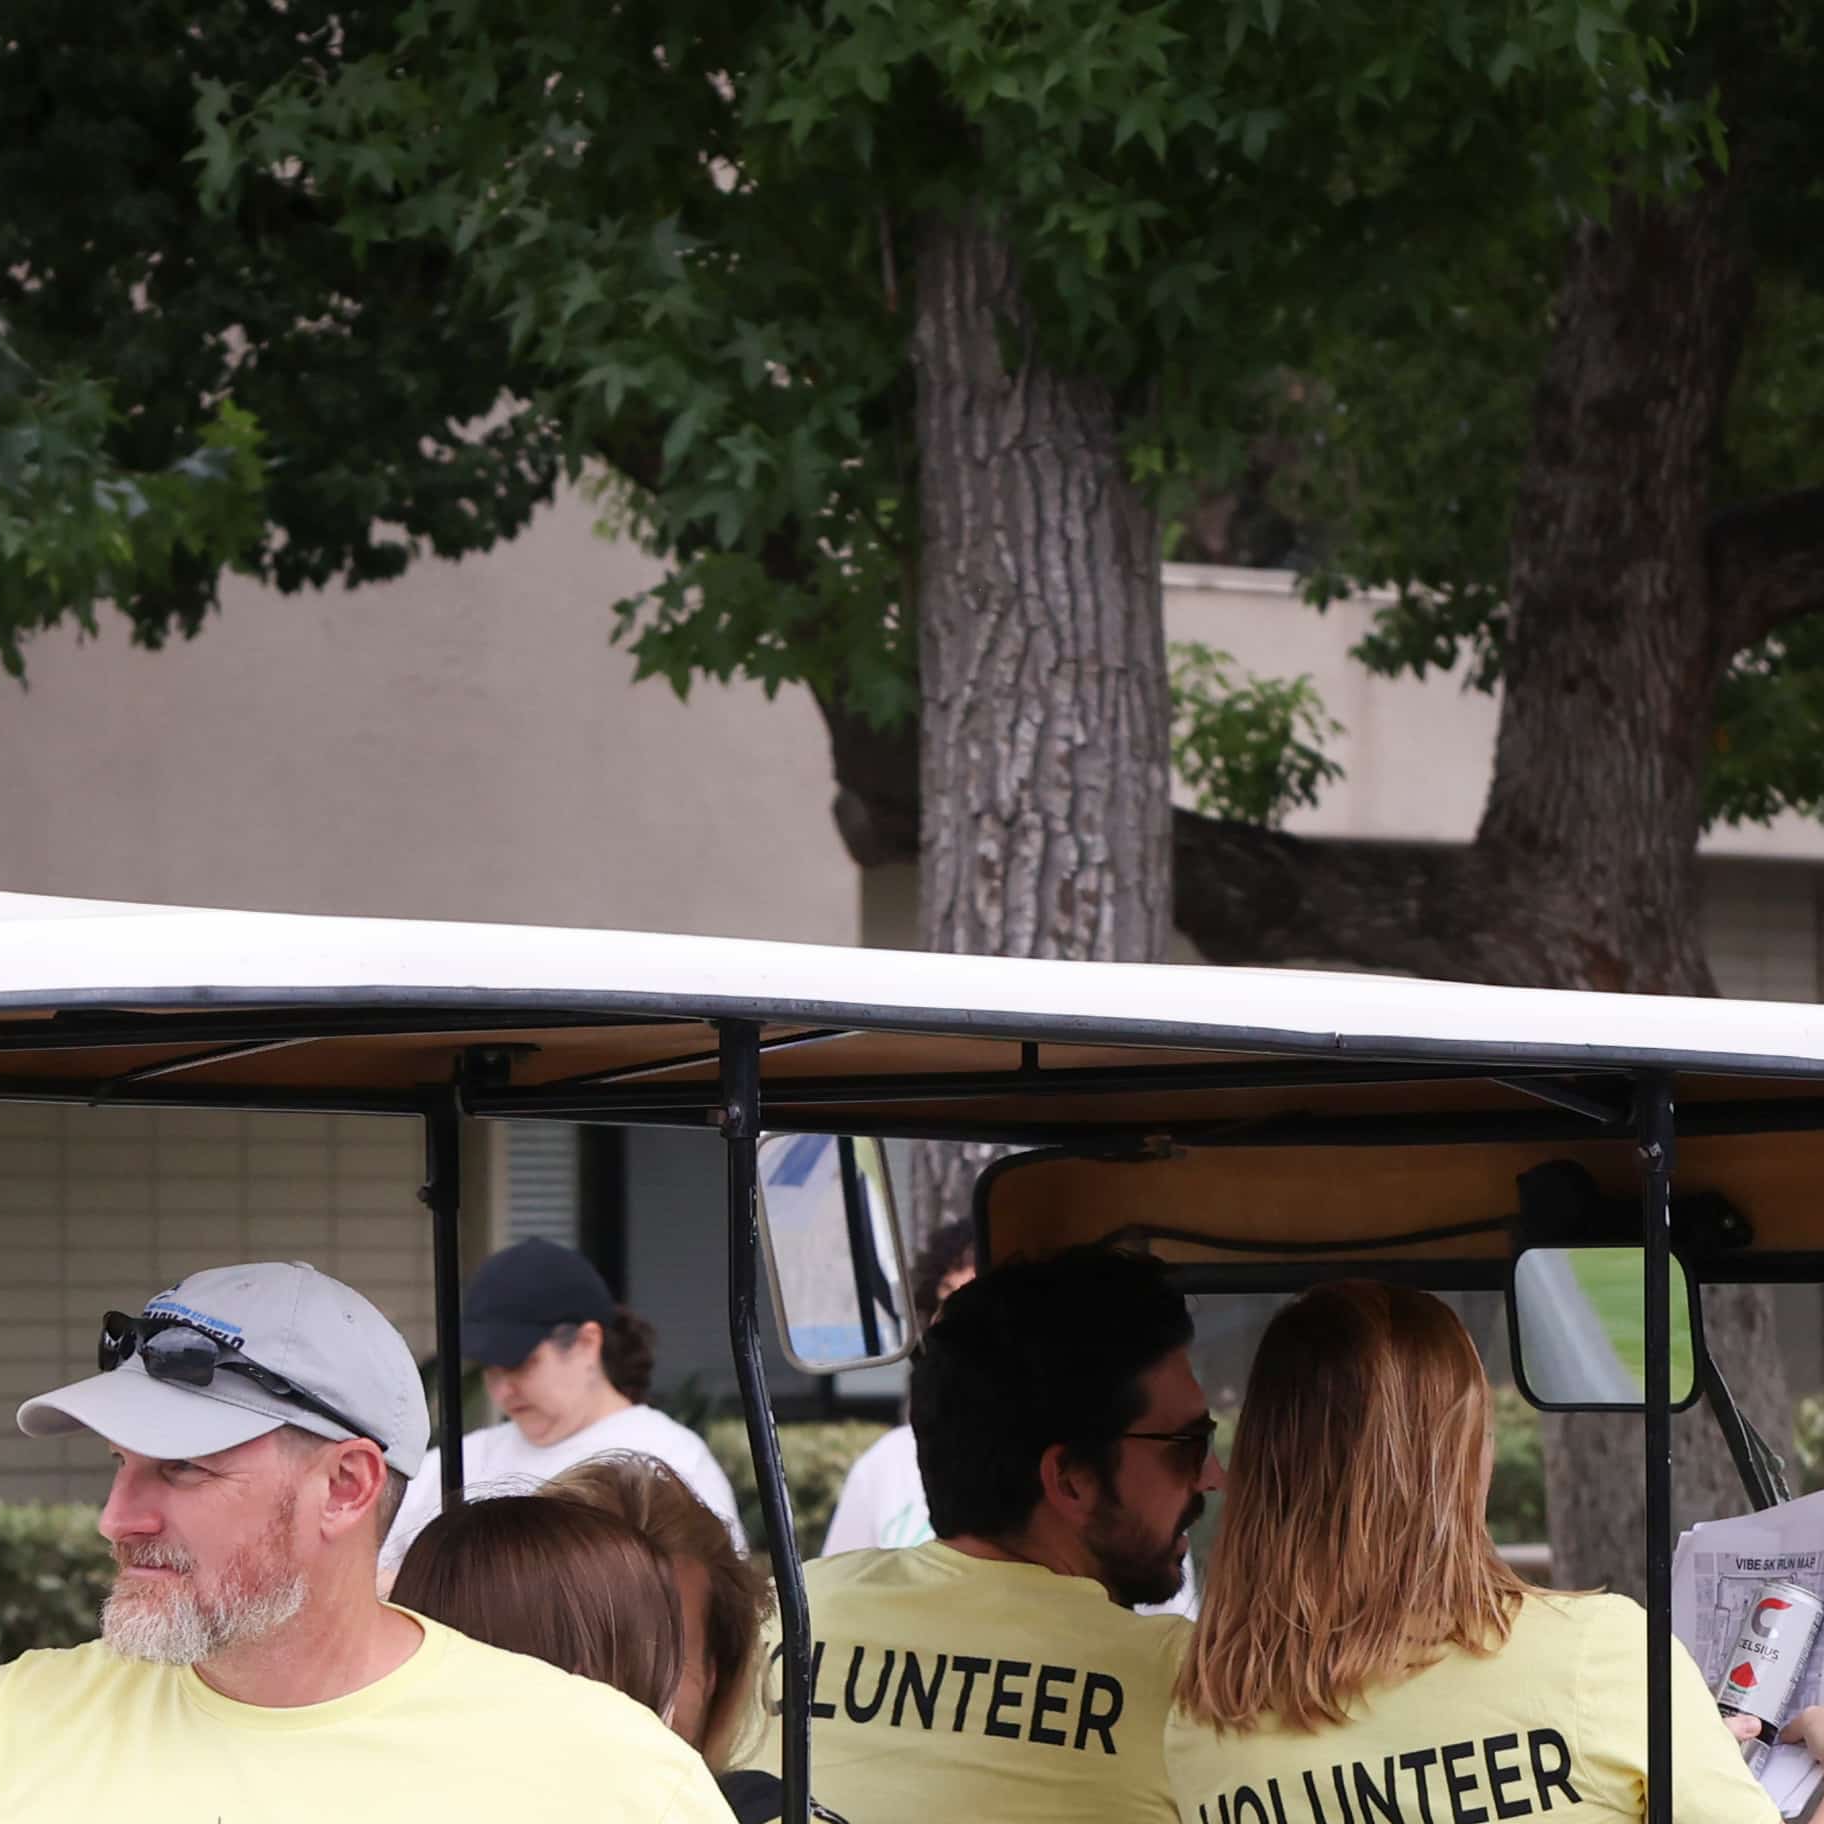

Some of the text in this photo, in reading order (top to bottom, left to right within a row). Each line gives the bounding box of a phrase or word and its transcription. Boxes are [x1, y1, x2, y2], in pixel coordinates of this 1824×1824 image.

[1736, 1556, 1816, 1570] VIBE 5K RUN MAP
[762, 1640, 1125, 1755] LUNTEER
